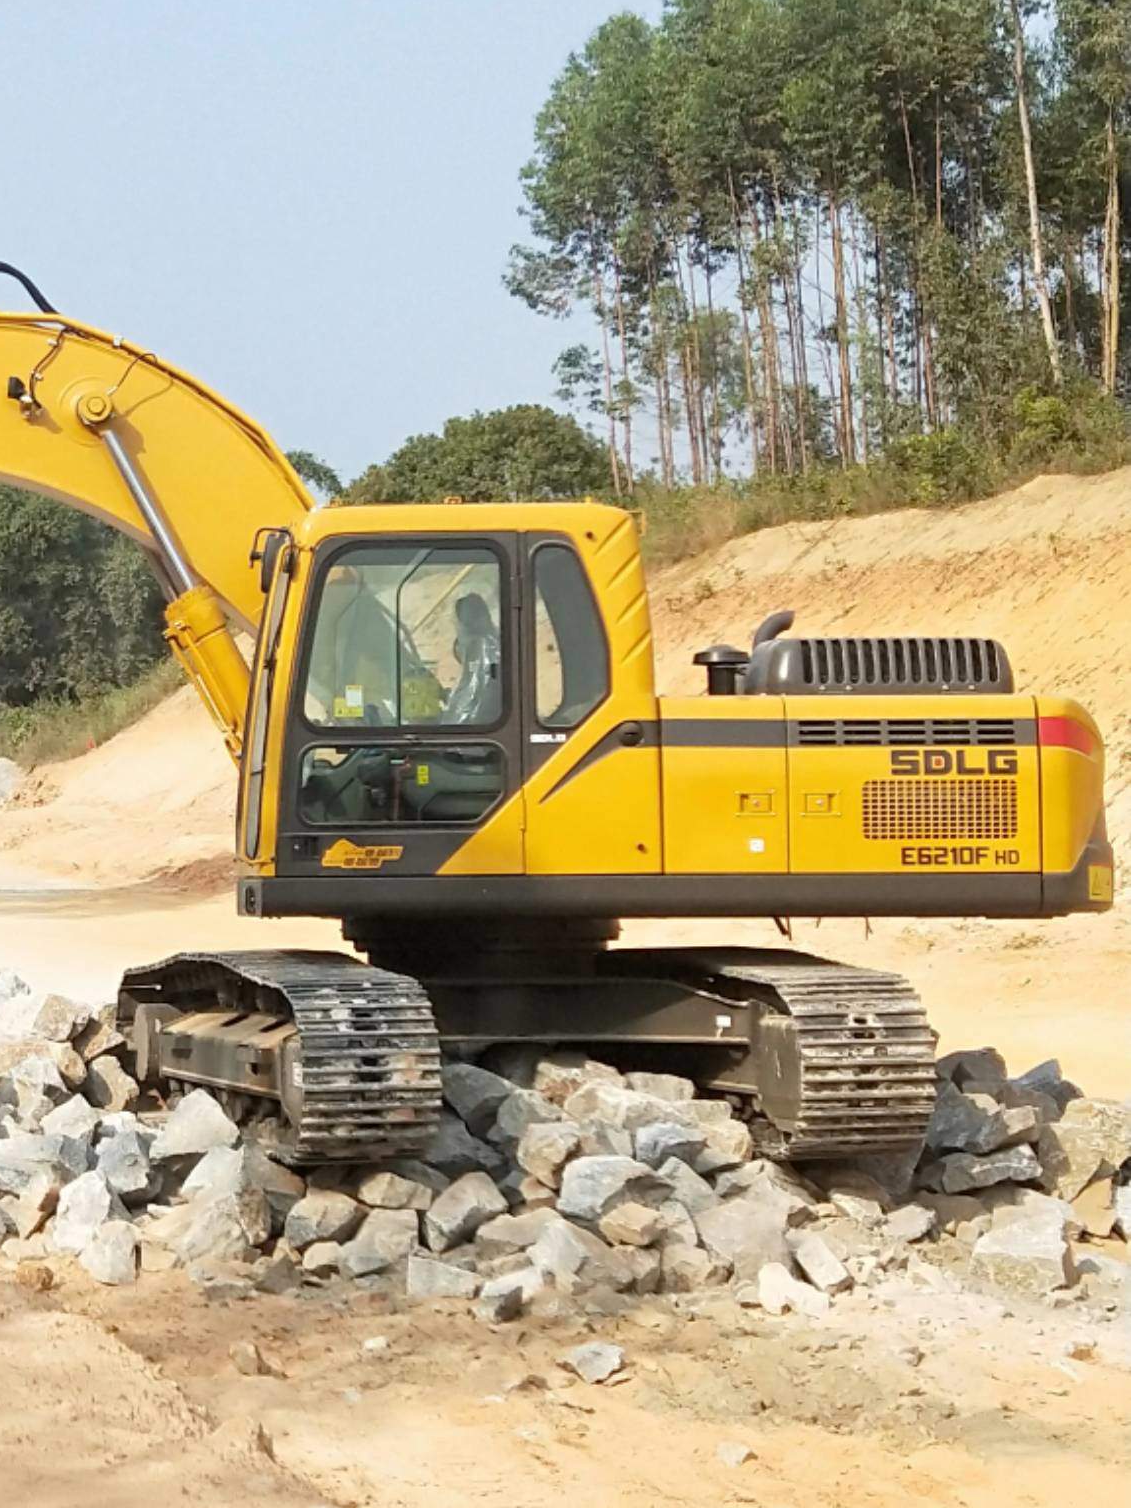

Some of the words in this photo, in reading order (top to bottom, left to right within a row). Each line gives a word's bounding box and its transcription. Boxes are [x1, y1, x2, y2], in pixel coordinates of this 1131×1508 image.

[891, 750, 1018, 776] SDLG
[901, 846, 988, 866] E6210F
[995, 850, 1020, 865] HD
